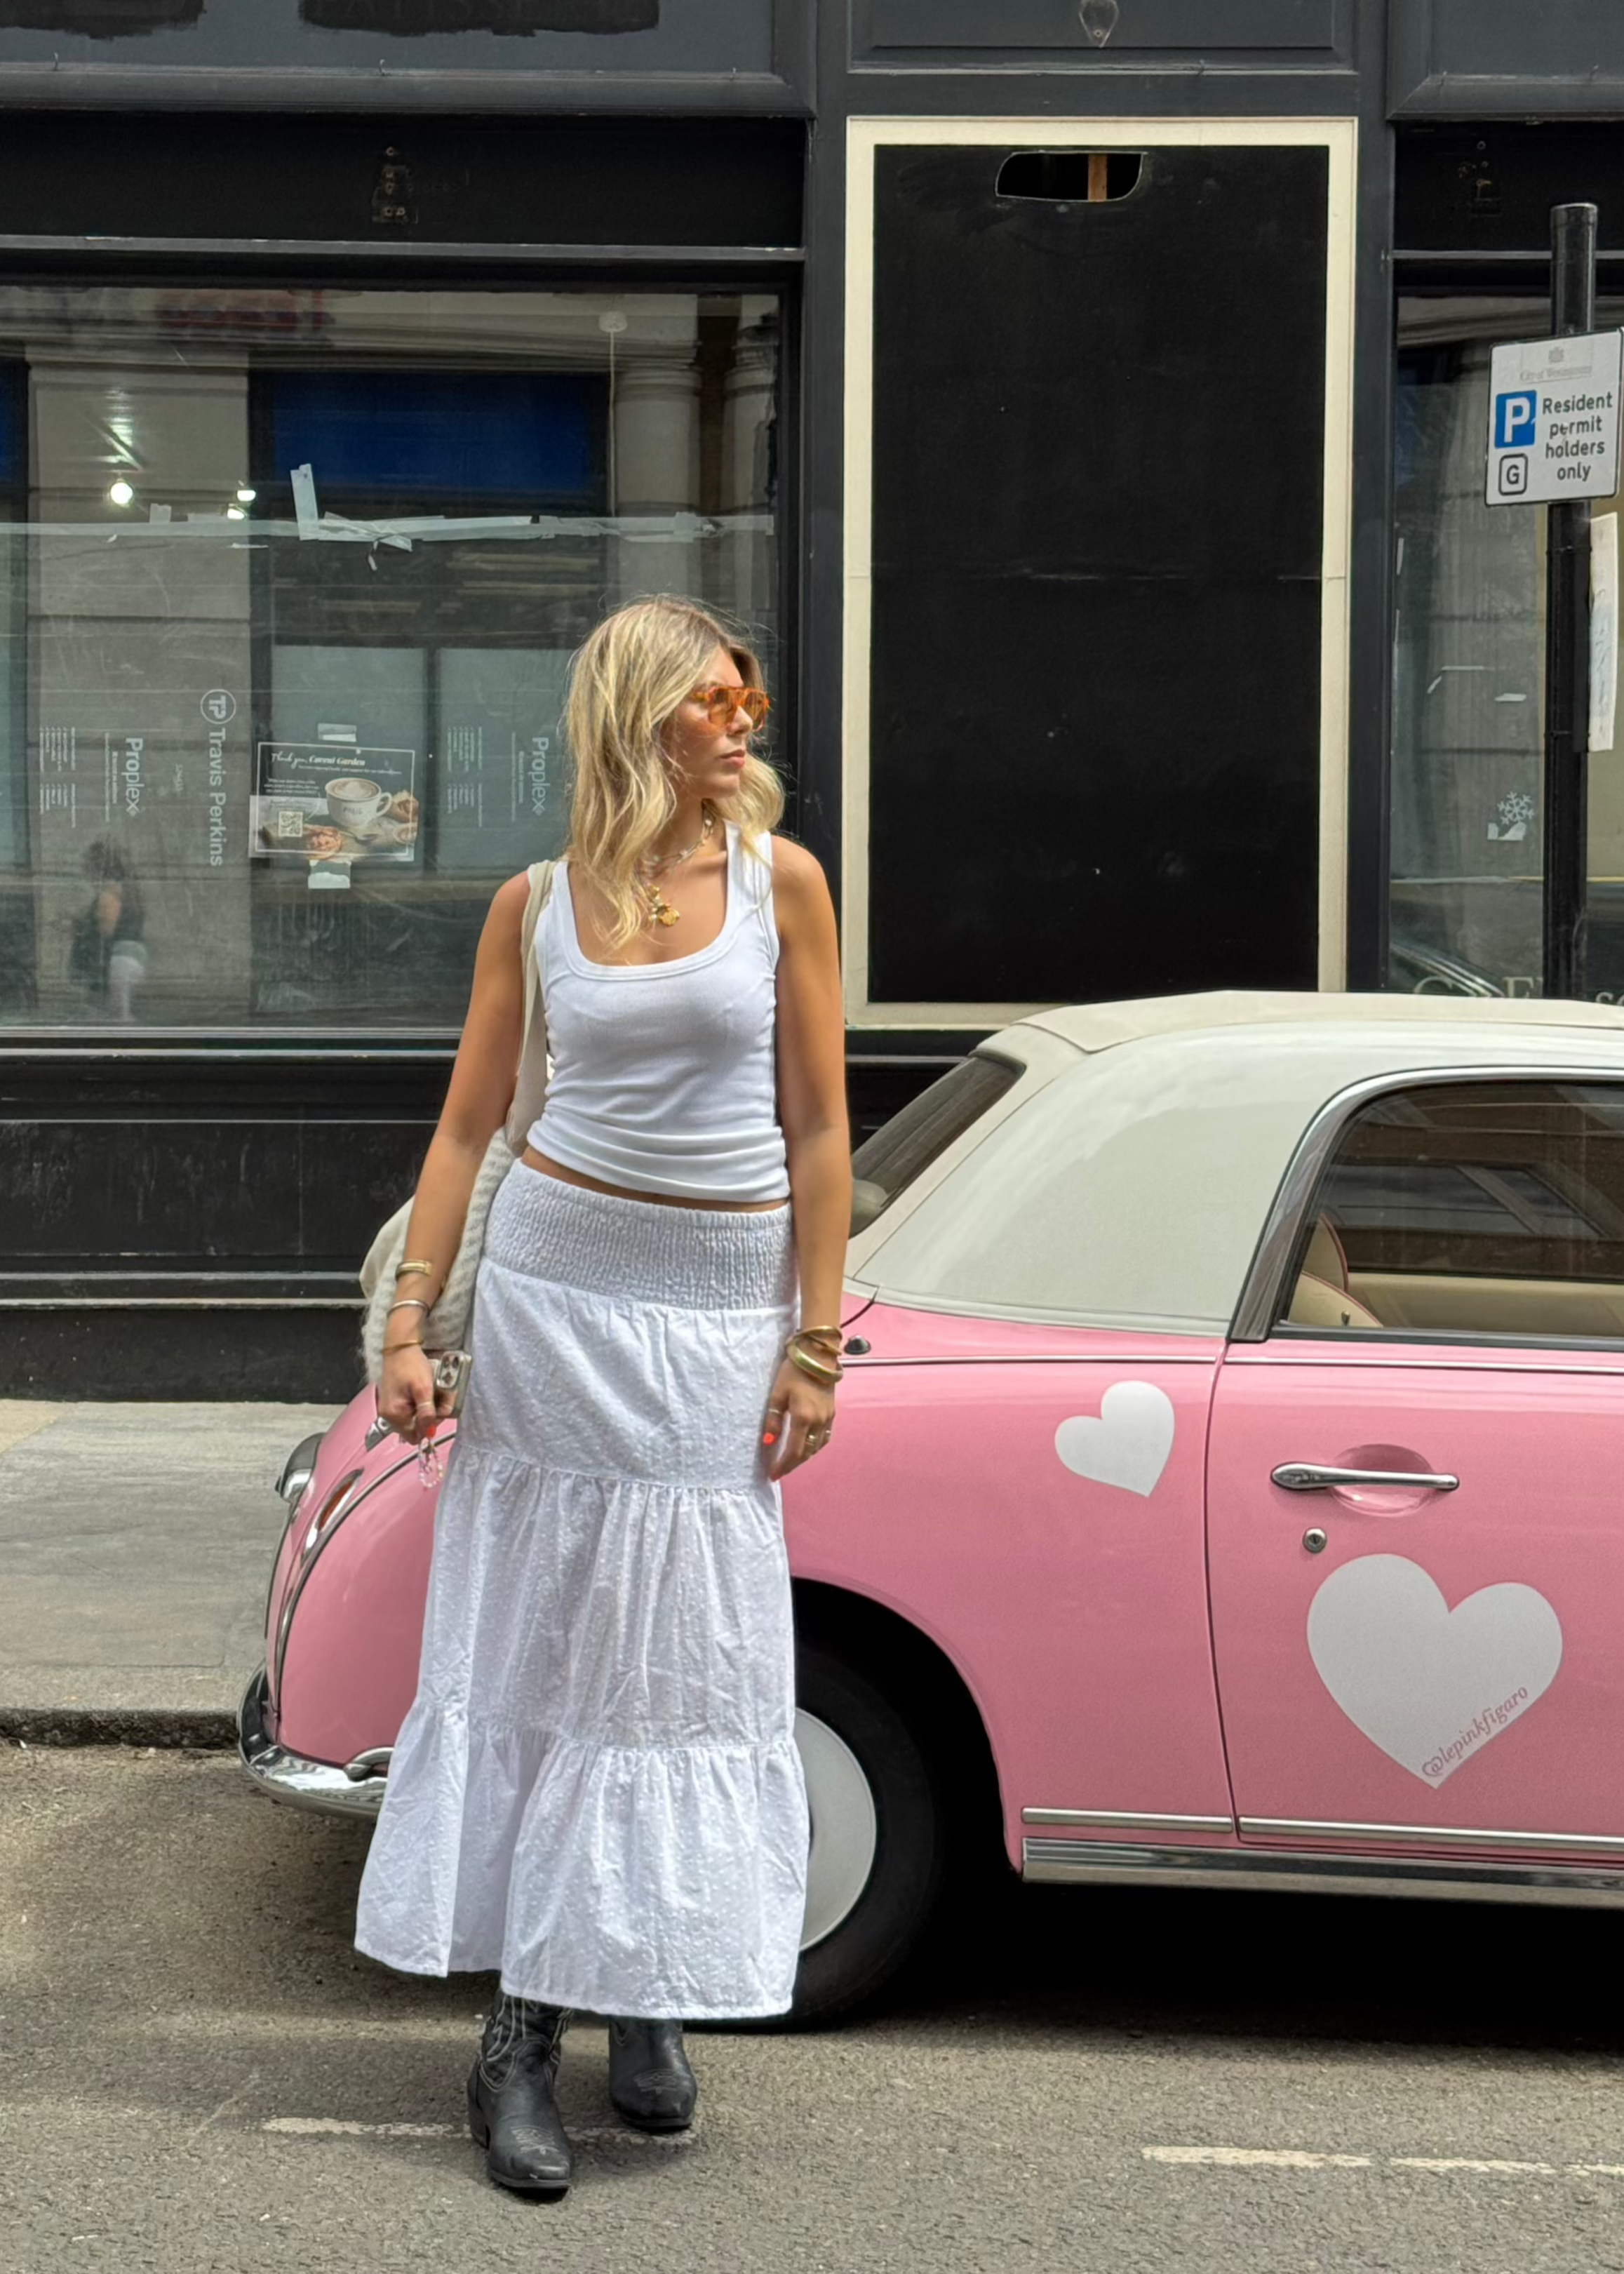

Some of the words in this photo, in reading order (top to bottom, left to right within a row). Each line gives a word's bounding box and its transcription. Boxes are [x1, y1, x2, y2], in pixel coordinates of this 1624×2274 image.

[1503, 396, 1531, 443] P
[1543, 392, 1613, 415] Resident
[1549, 415, 1602, 439] permit
[1545, 441, 1605, 460] holders
[1505, 464, 1520, 485] G
[1557, 461, 1591, 482] only
[209, 695, 227, 719] TP
[121, 737, 145, 812] Proplex
[209, 728, 227, 786] Travis
[528, 737, 551, 812] Proplex
[209, 792, 227, 867] Perkins
[1421, 1686, 1528, 1777] @lepinkfigaro
